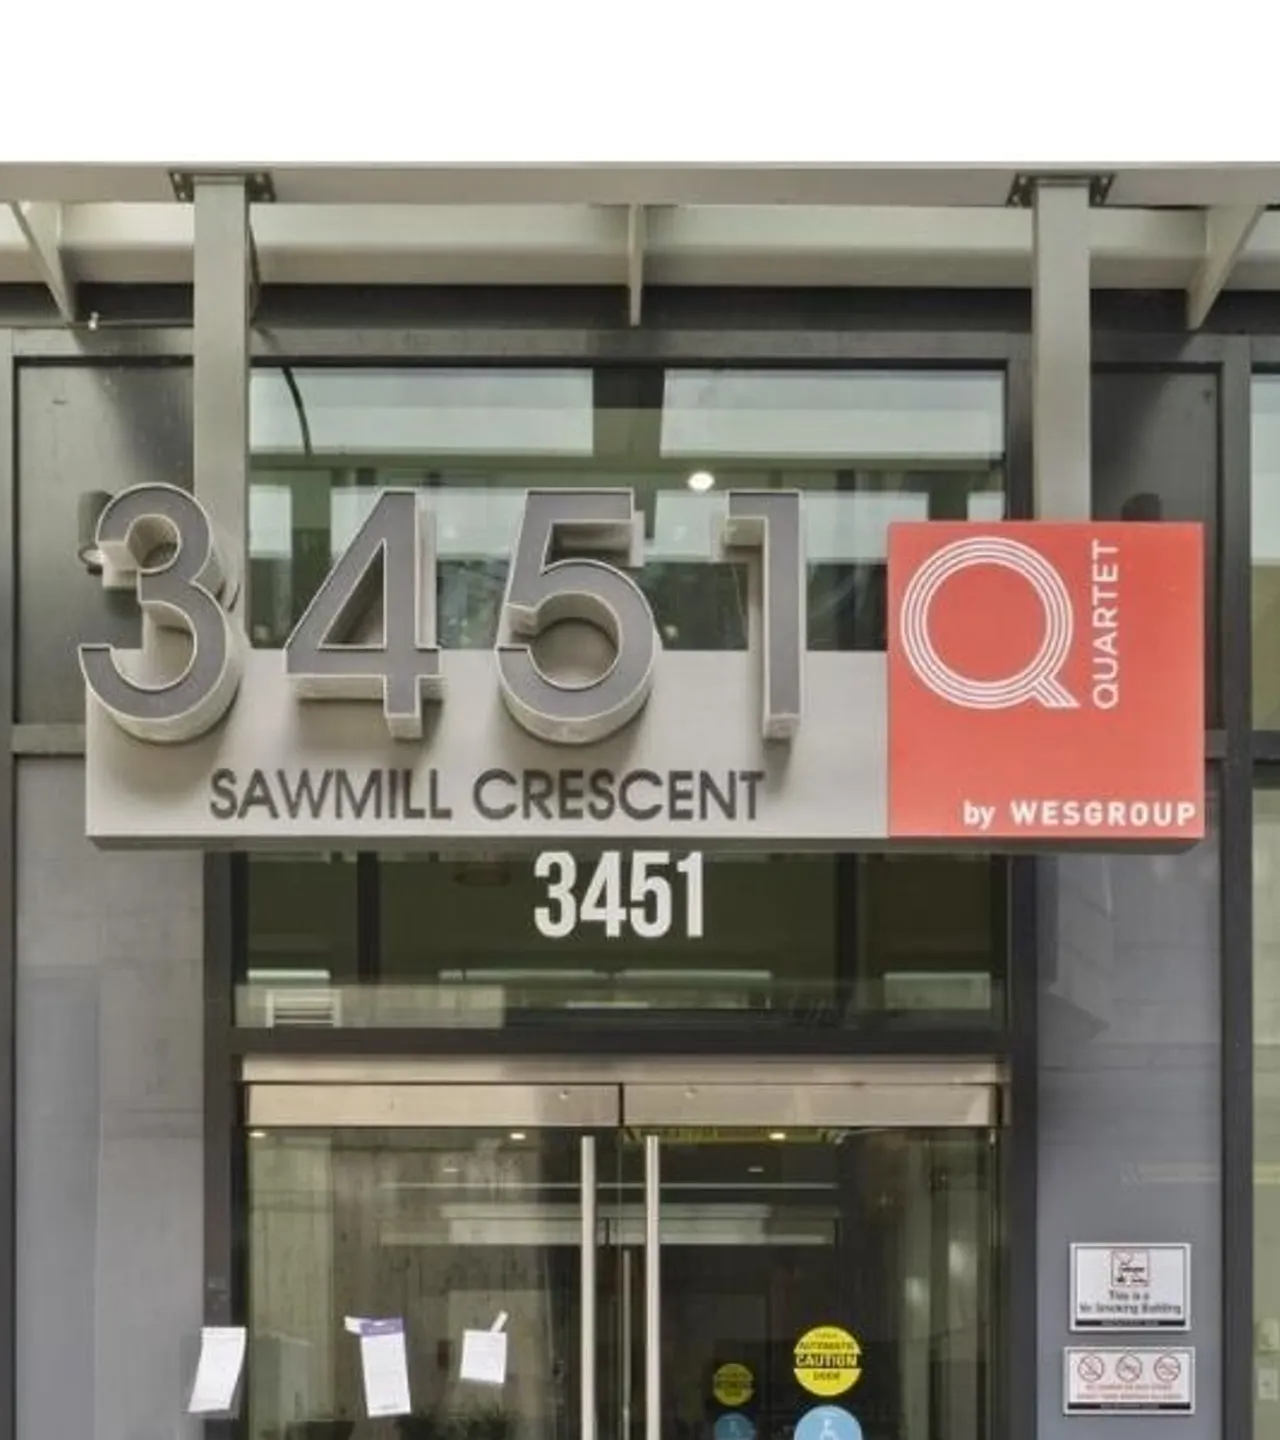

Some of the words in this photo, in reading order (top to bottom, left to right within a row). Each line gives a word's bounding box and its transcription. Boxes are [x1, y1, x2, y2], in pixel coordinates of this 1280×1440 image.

[78, 482, 808, 743] 3451
[1092, 538, 1120, 710] QUARTET
[209, 768, 451, 820] SAWMILL
[472, 768, 764, 820] CRESCENT
[962, 799, 995, 830] by
[1009, 800, 1197, 828] WESGROUP
[532, 851, 705, 937] 3451
[796, 1355, 857, 1367] CAUTION
